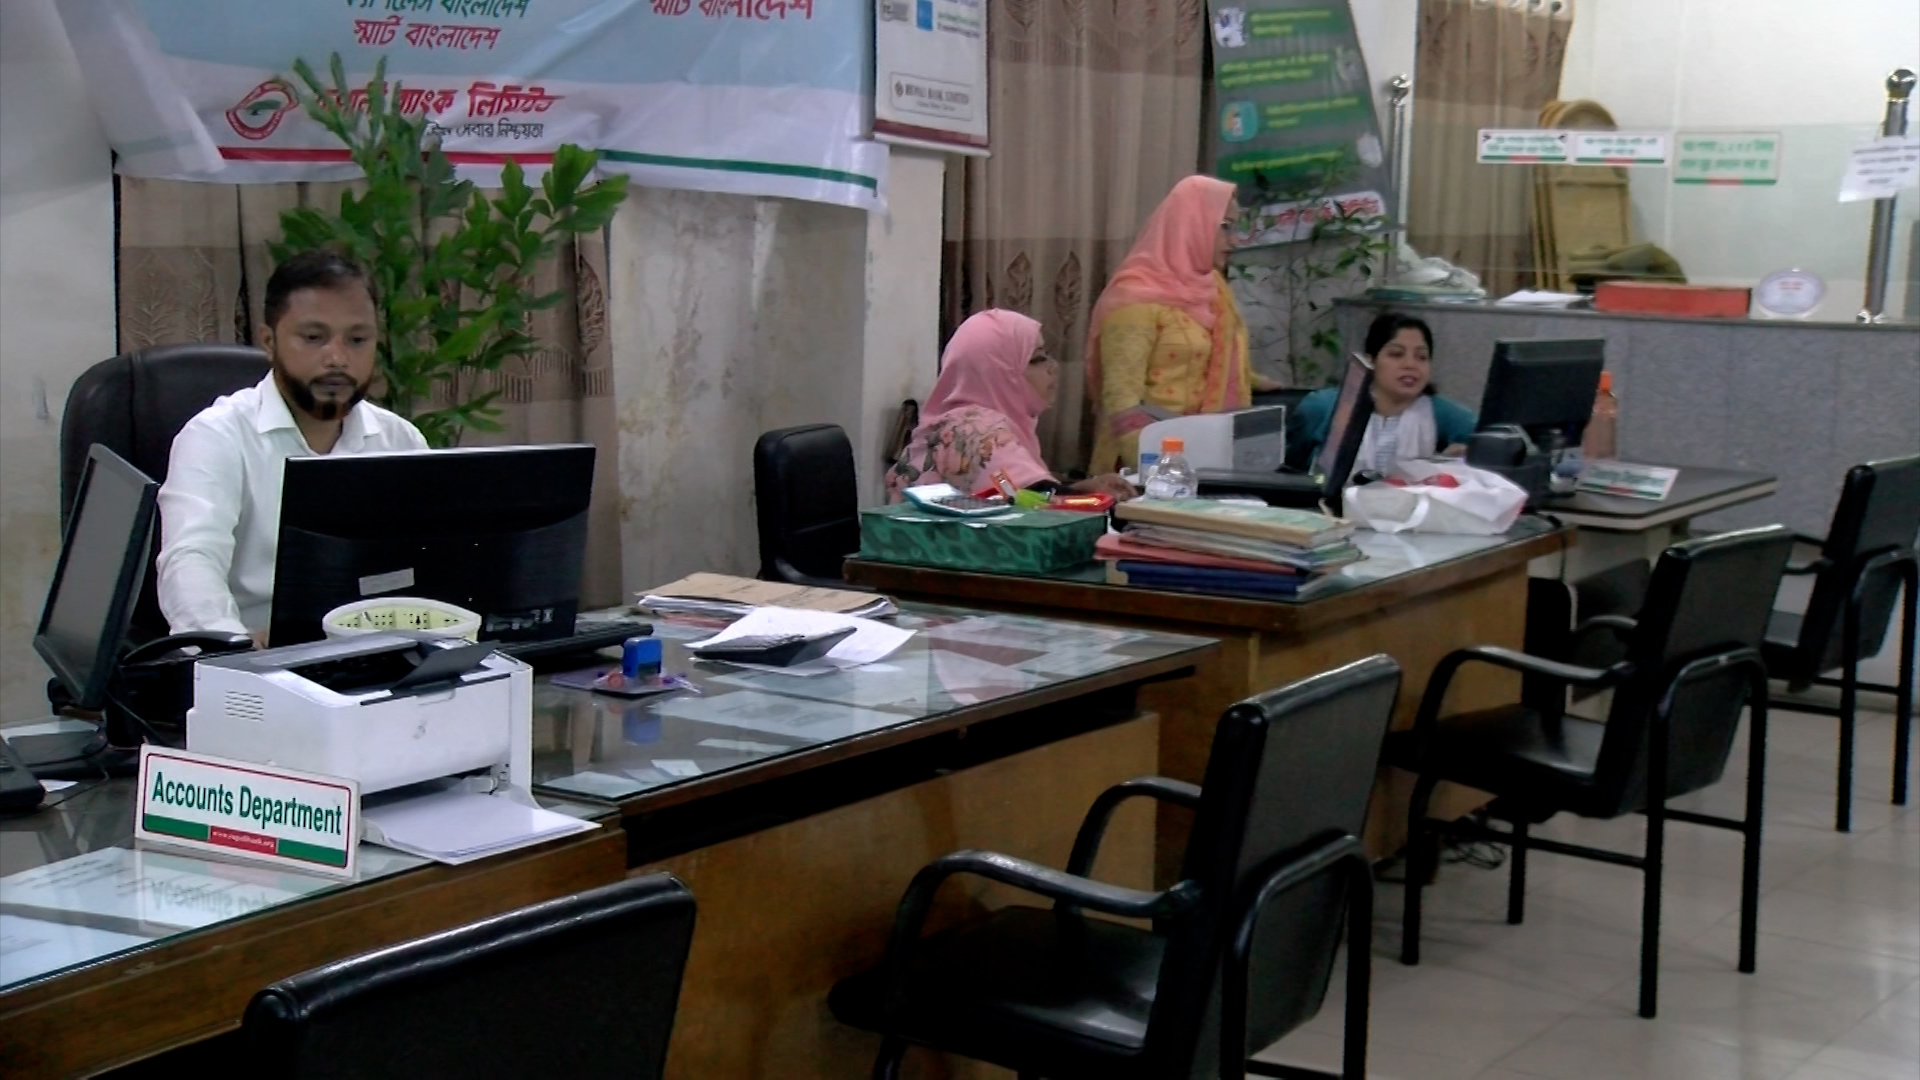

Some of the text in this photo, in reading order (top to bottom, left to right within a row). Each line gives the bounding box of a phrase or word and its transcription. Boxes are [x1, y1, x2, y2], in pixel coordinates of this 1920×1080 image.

[353, 15, 502, 50] স্মার্ট বাংলাদেশ
[152, 771, 342, 836] Accounts Department
